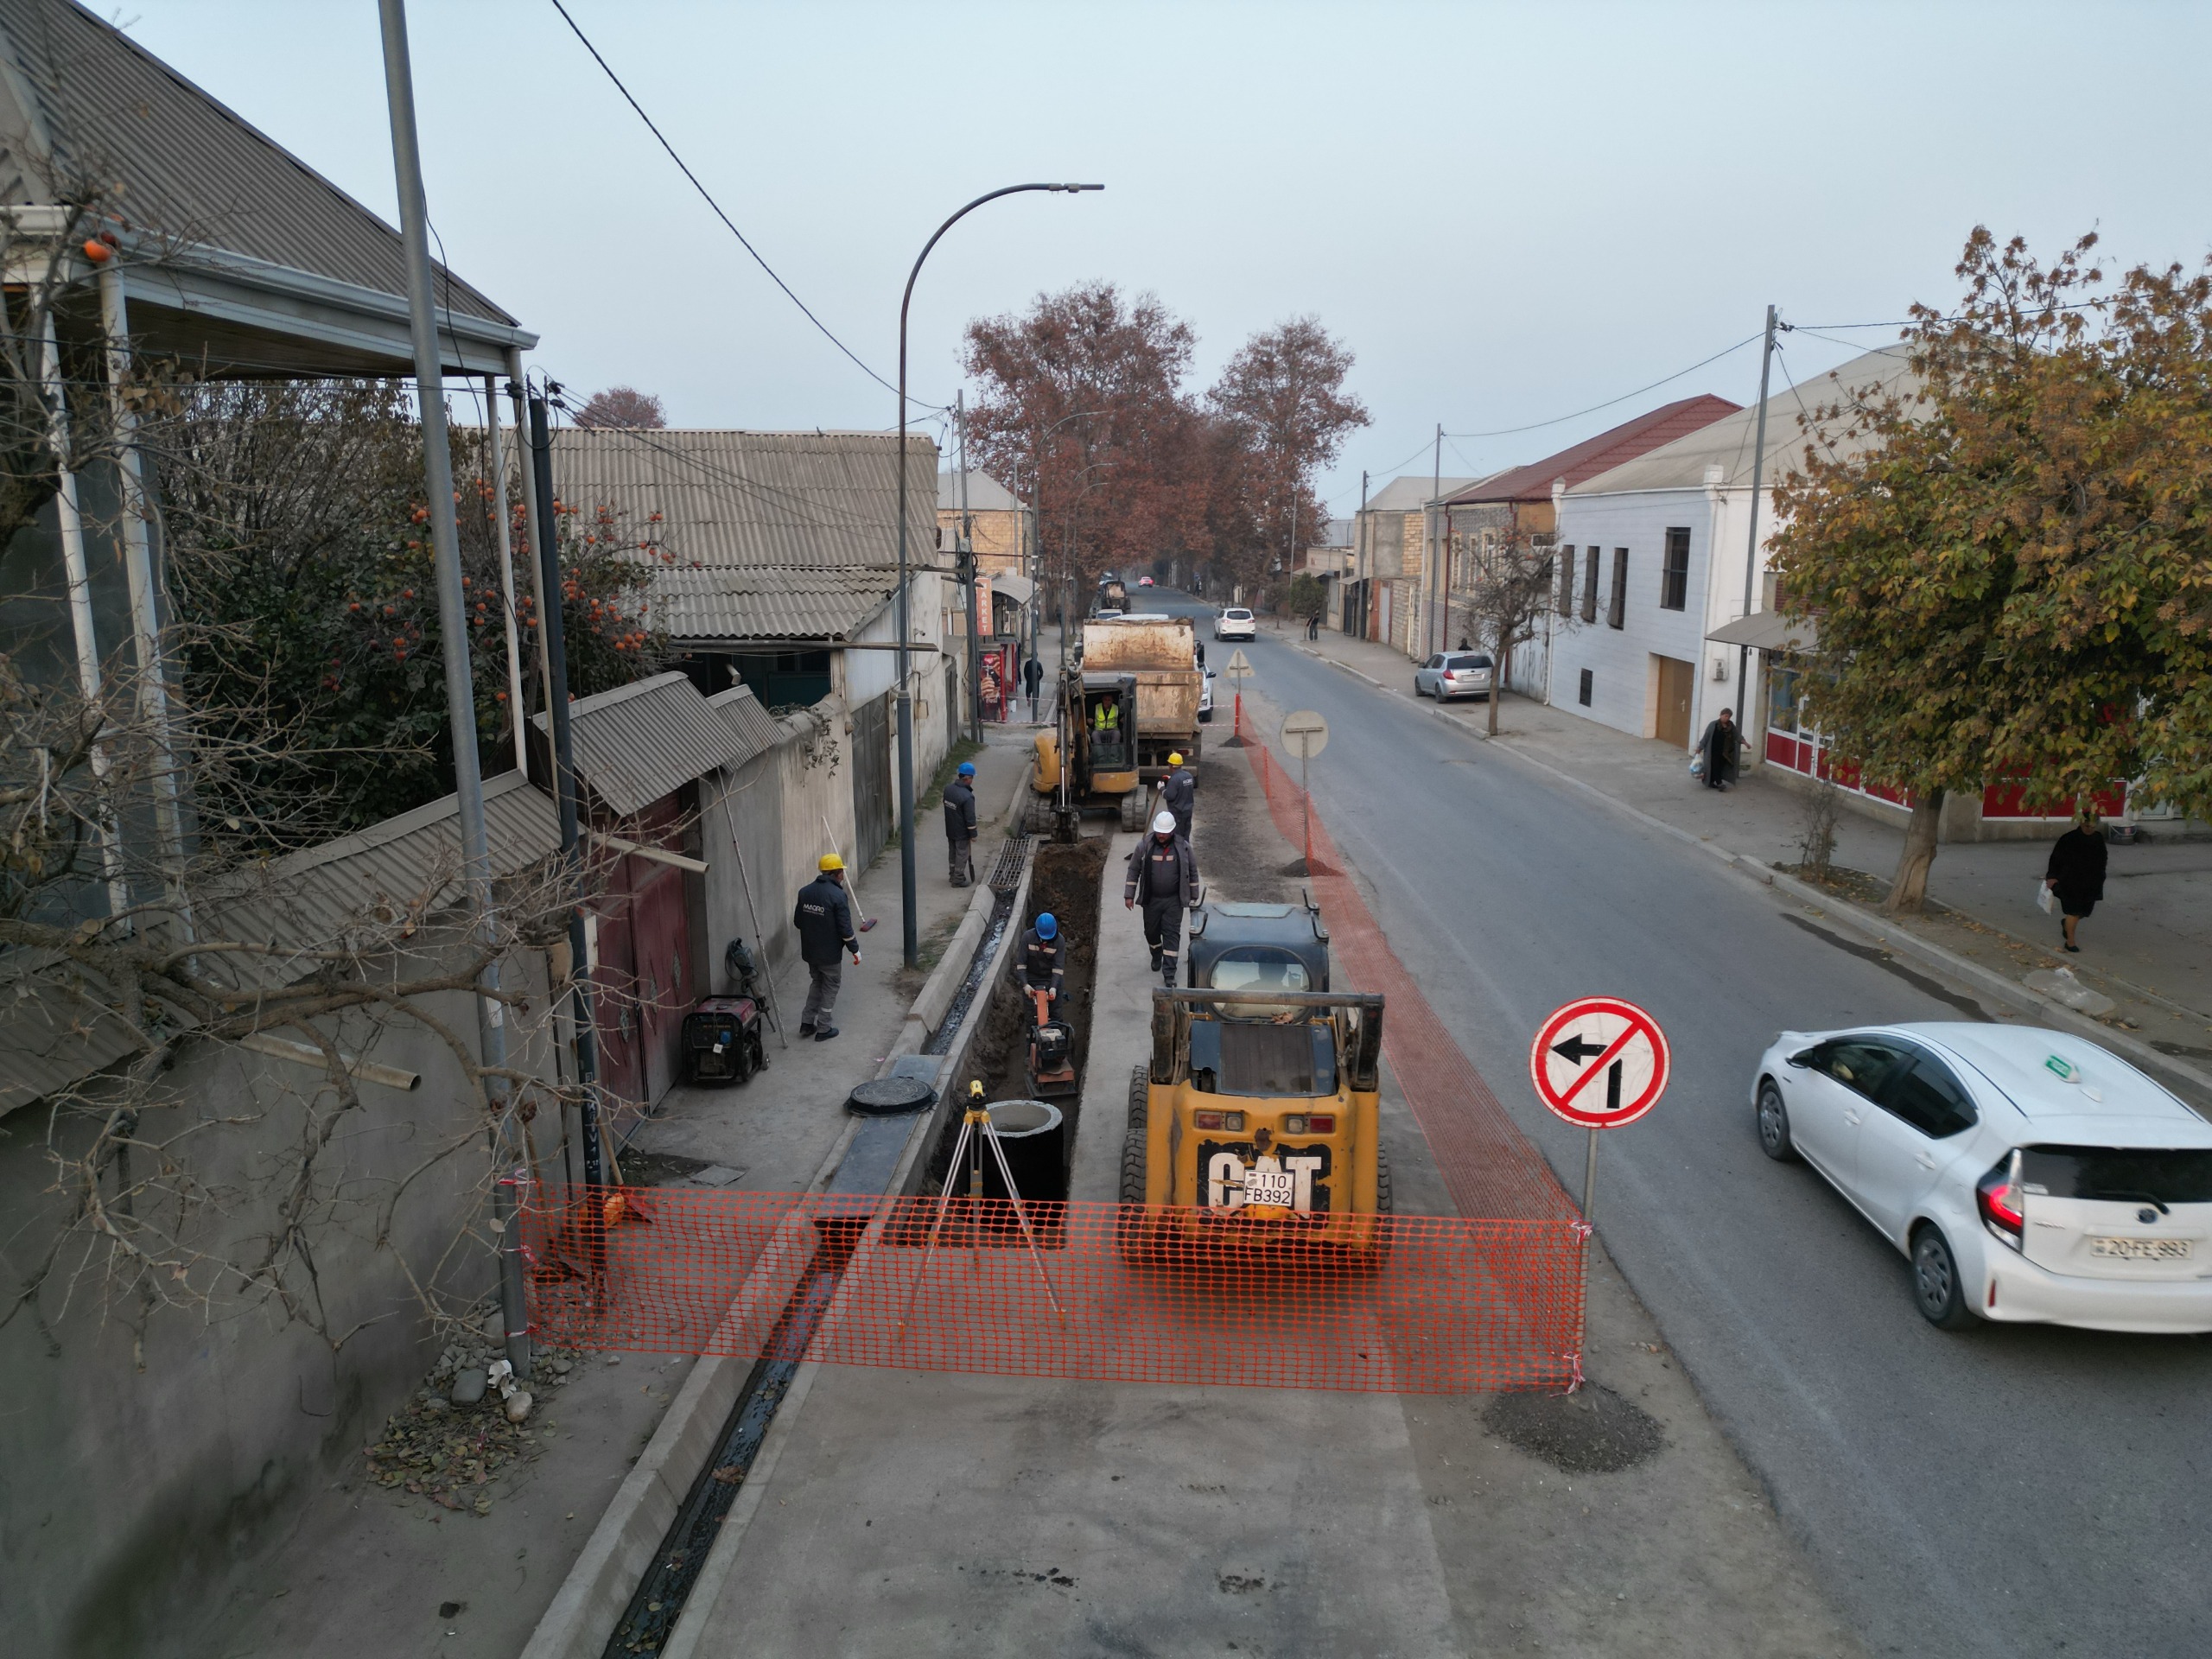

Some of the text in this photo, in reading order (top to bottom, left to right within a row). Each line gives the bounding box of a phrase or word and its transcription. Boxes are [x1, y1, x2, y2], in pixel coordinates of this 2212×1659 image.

[1209, 1153, 1322, 1219] CT
[1262, 1174, 1287, 1189] 110
[1245, 1188, 1291, 1205] FB392
